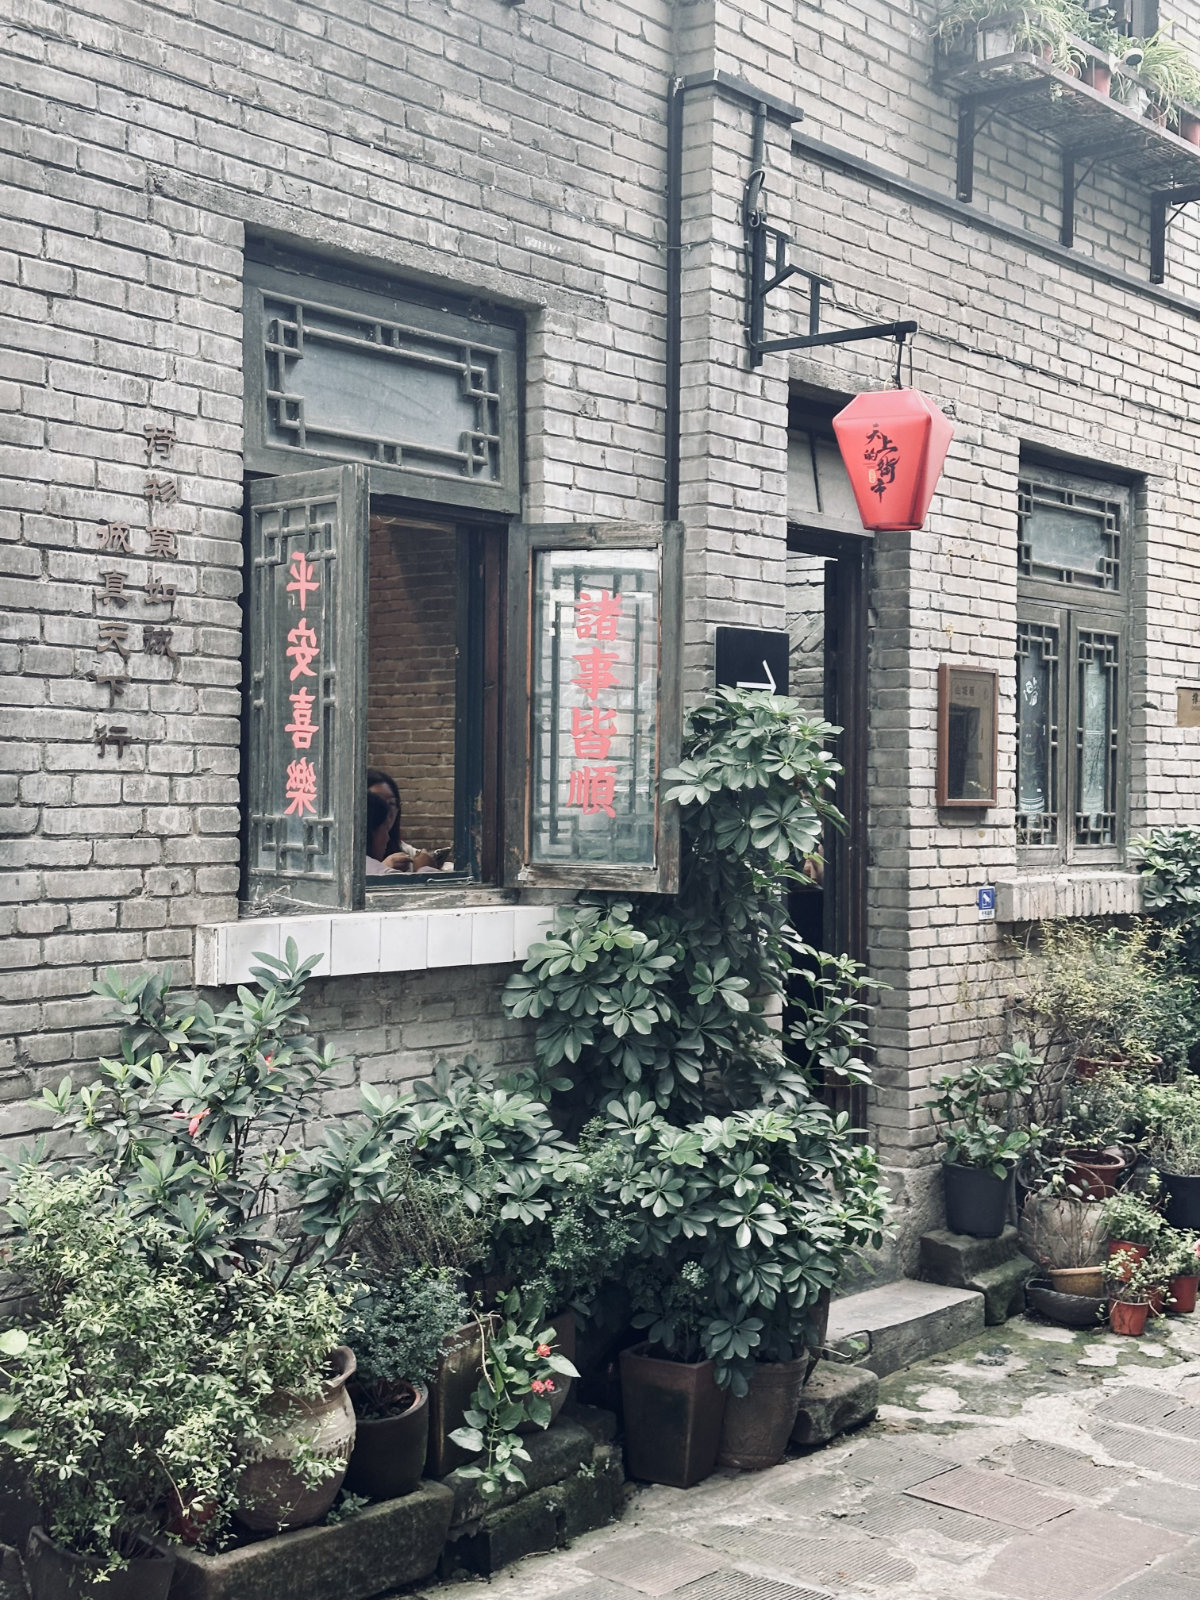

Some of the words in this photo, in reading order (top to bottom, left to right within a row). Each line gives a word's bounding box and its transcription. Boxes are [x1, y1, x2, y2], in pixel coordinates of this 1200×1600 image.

[284, 550, 320, 818] 平安喜樂
[566, 589, 624, 819] 諸事皆順
